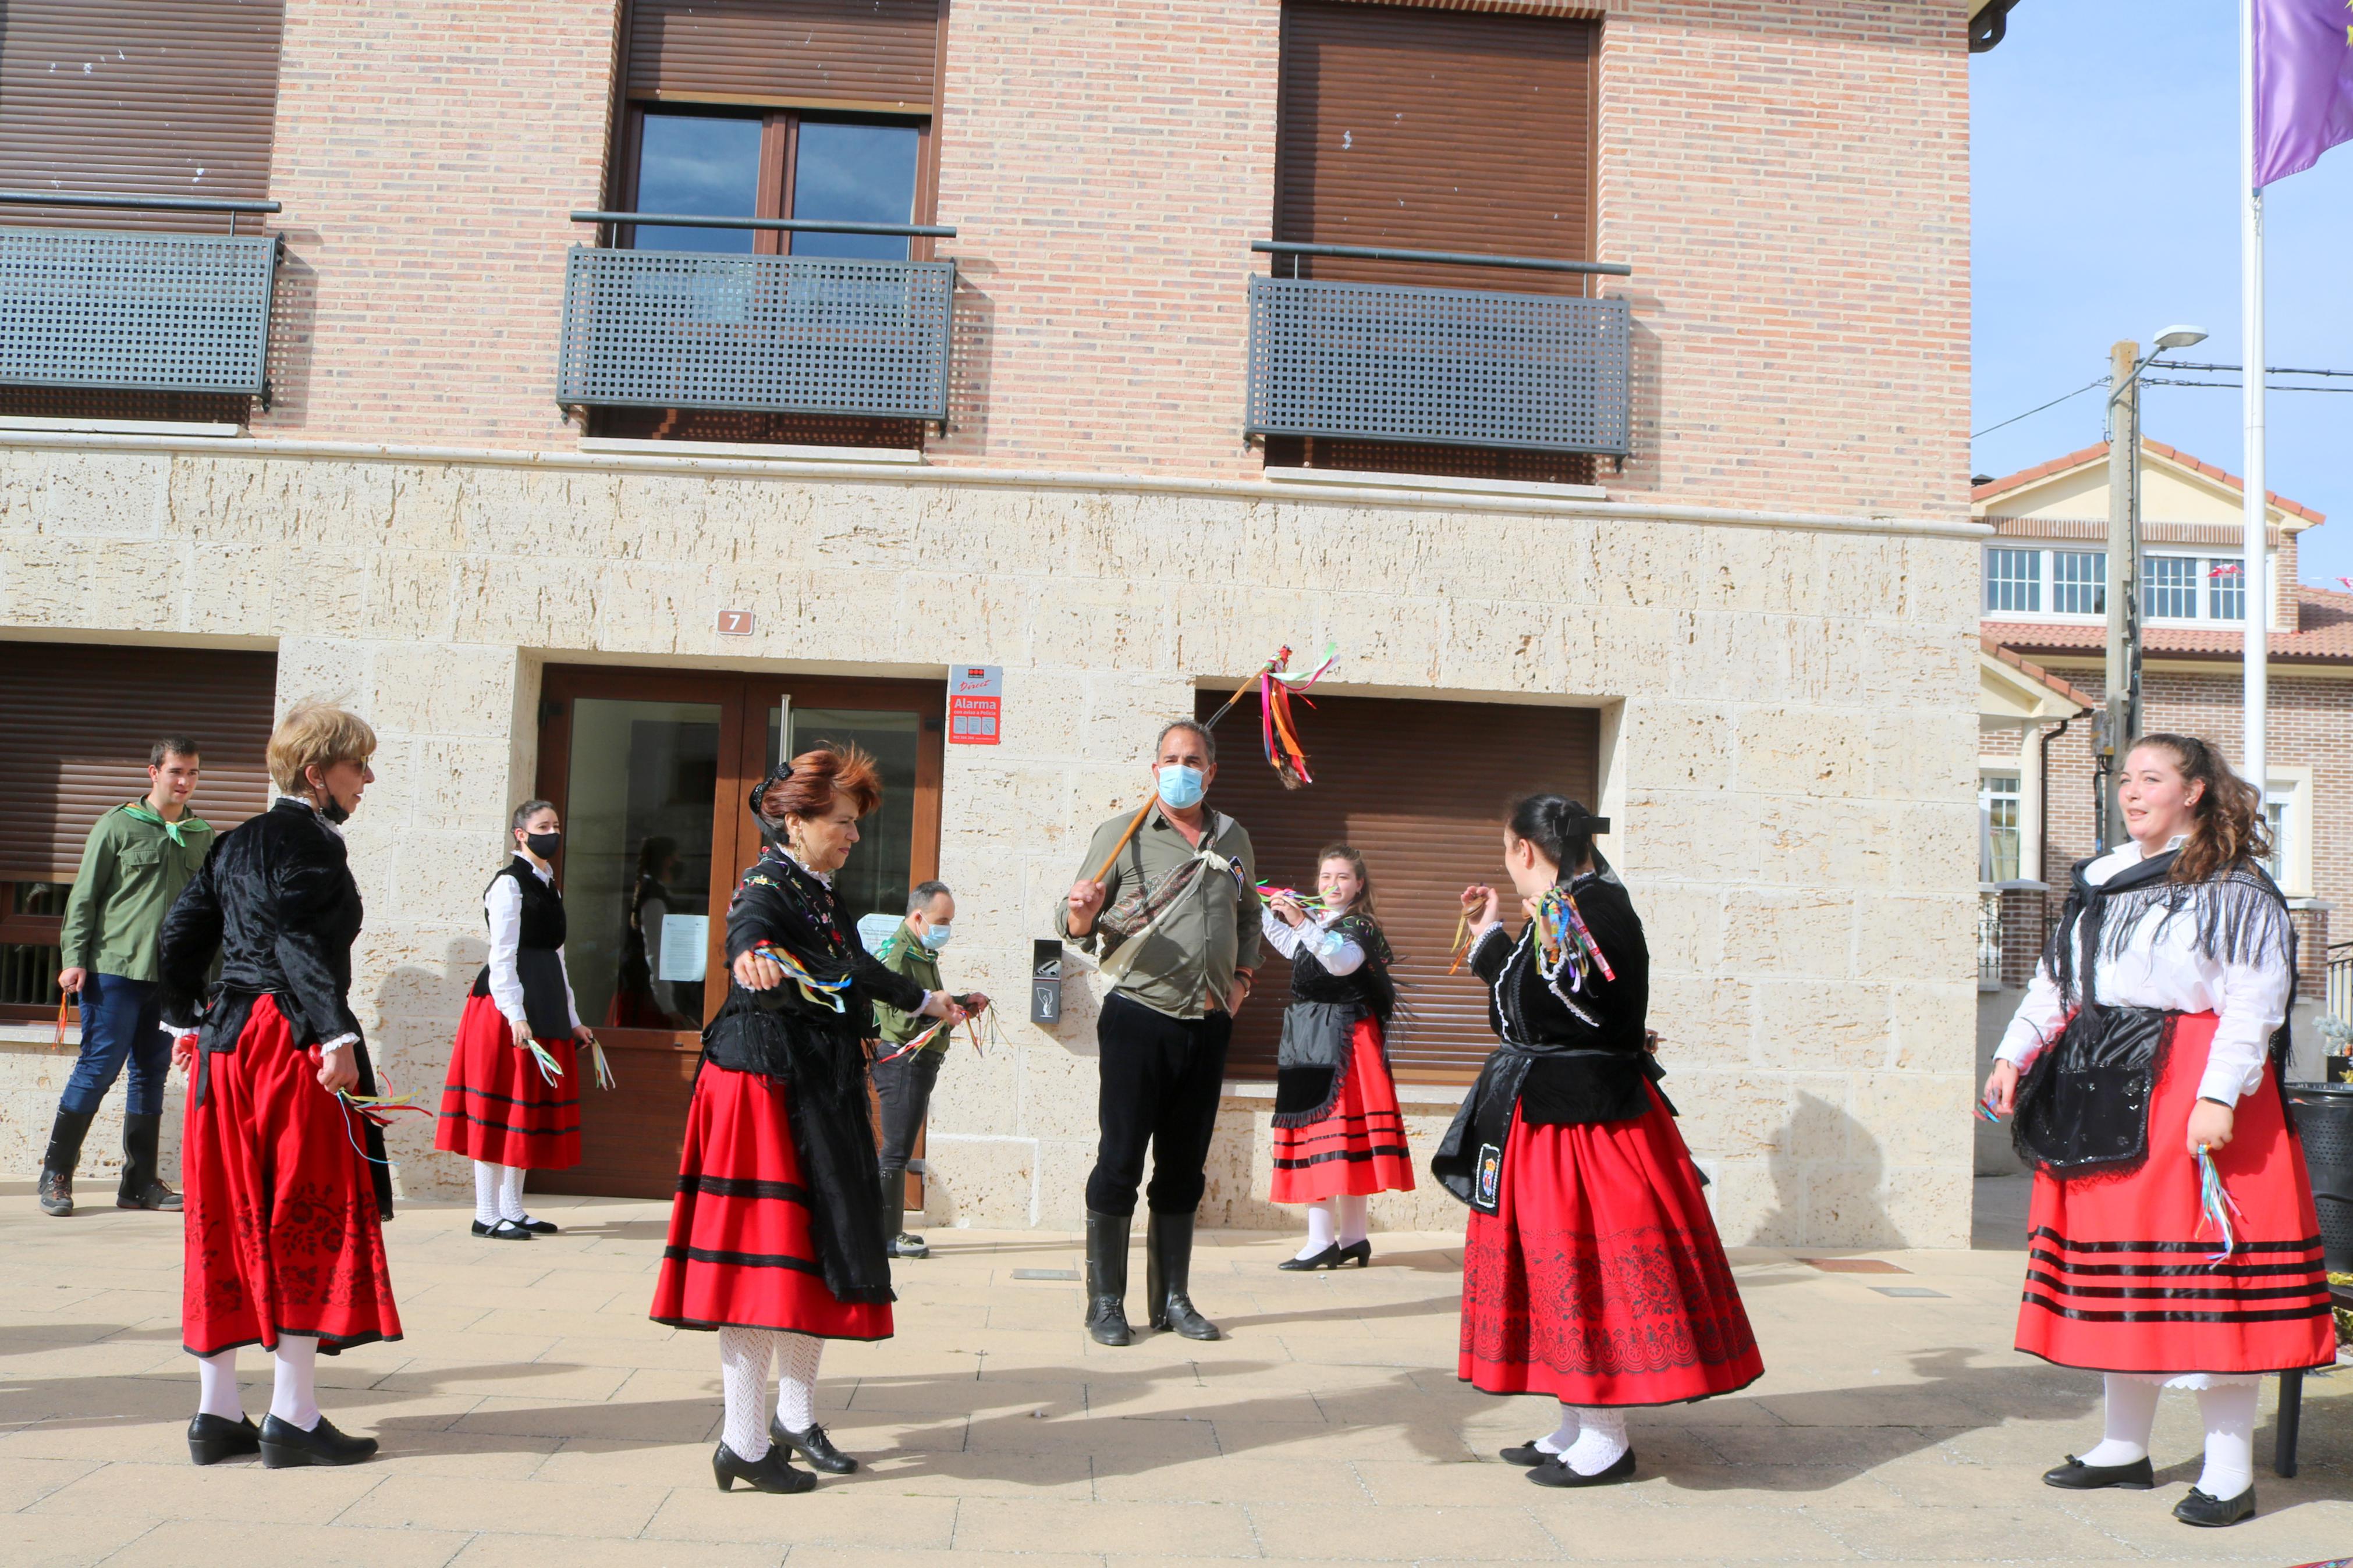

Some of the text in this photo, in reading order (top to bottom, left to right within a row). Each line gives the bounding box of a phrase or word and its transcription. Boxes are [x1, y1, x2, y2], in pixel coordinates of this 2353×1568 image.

[729, 614, 740, 630] 7
[960, 680, 991, 692] Direct
[954, 698, 996, 709] Alarma
[2316, 913, 2322, 922] 9
